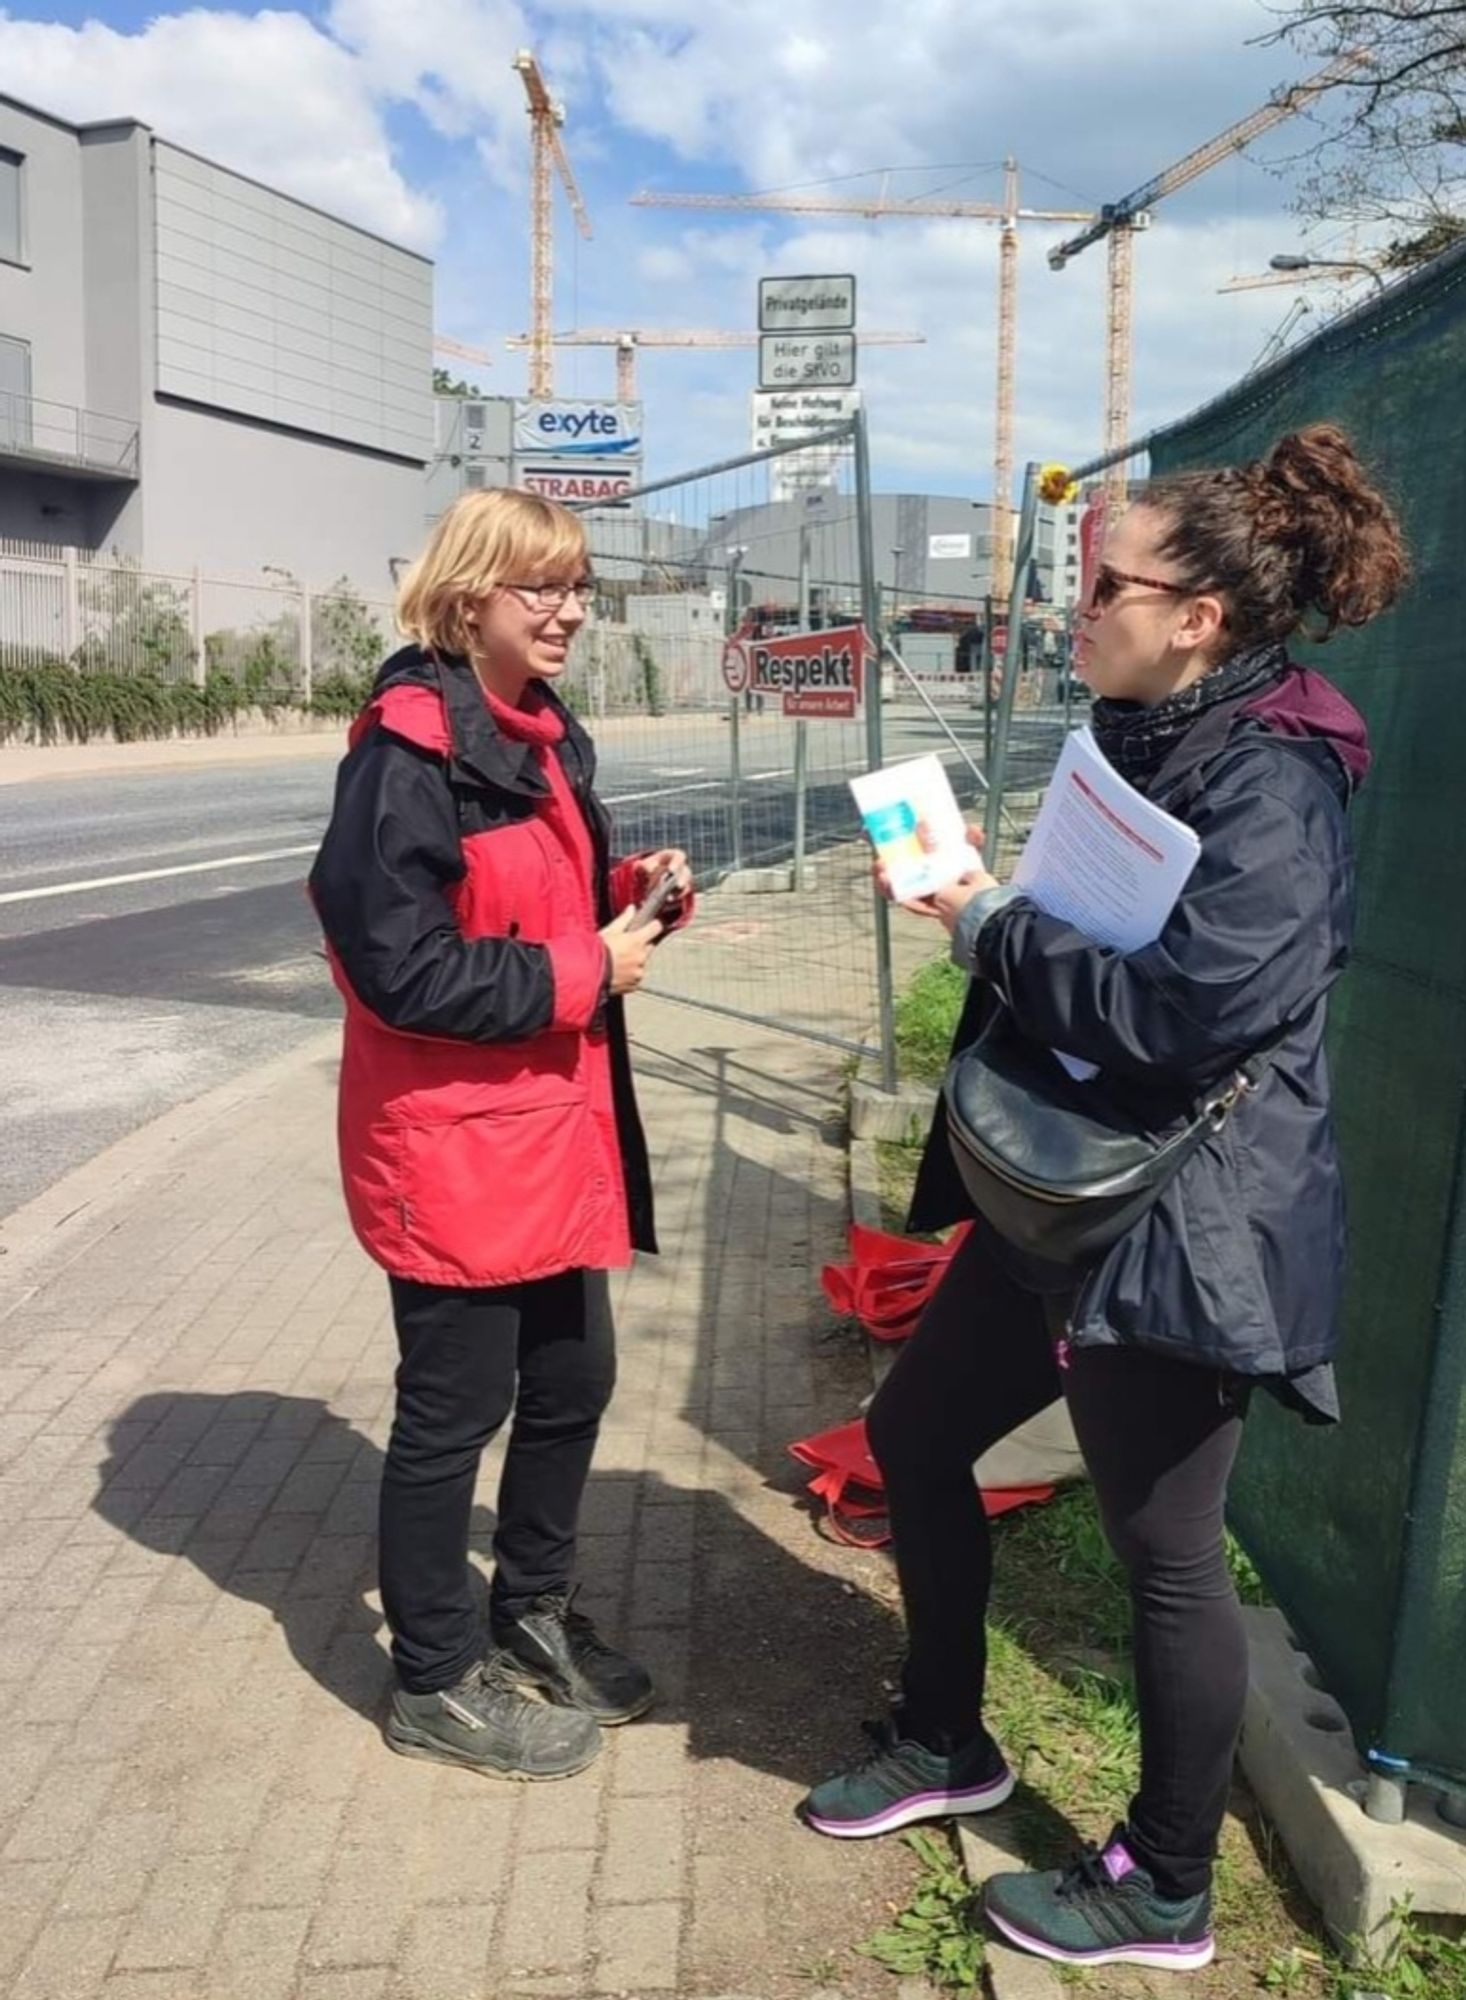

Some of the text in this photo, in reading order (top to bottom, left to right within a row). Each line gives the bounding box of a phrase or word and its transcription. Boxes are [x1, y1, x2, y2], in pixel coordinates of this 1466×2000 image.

[766, 294, 848, 316] Privatgelände
[774, 342, 841, 360] Hier gilt
[773, 362, 841, 379] die StVO
[538, 409, 618, 438] exyte
[469, 436, 481, 449] 2
[524, 477, 631, 498] STRABAG
[755, 648, 852, 694] Respekt
